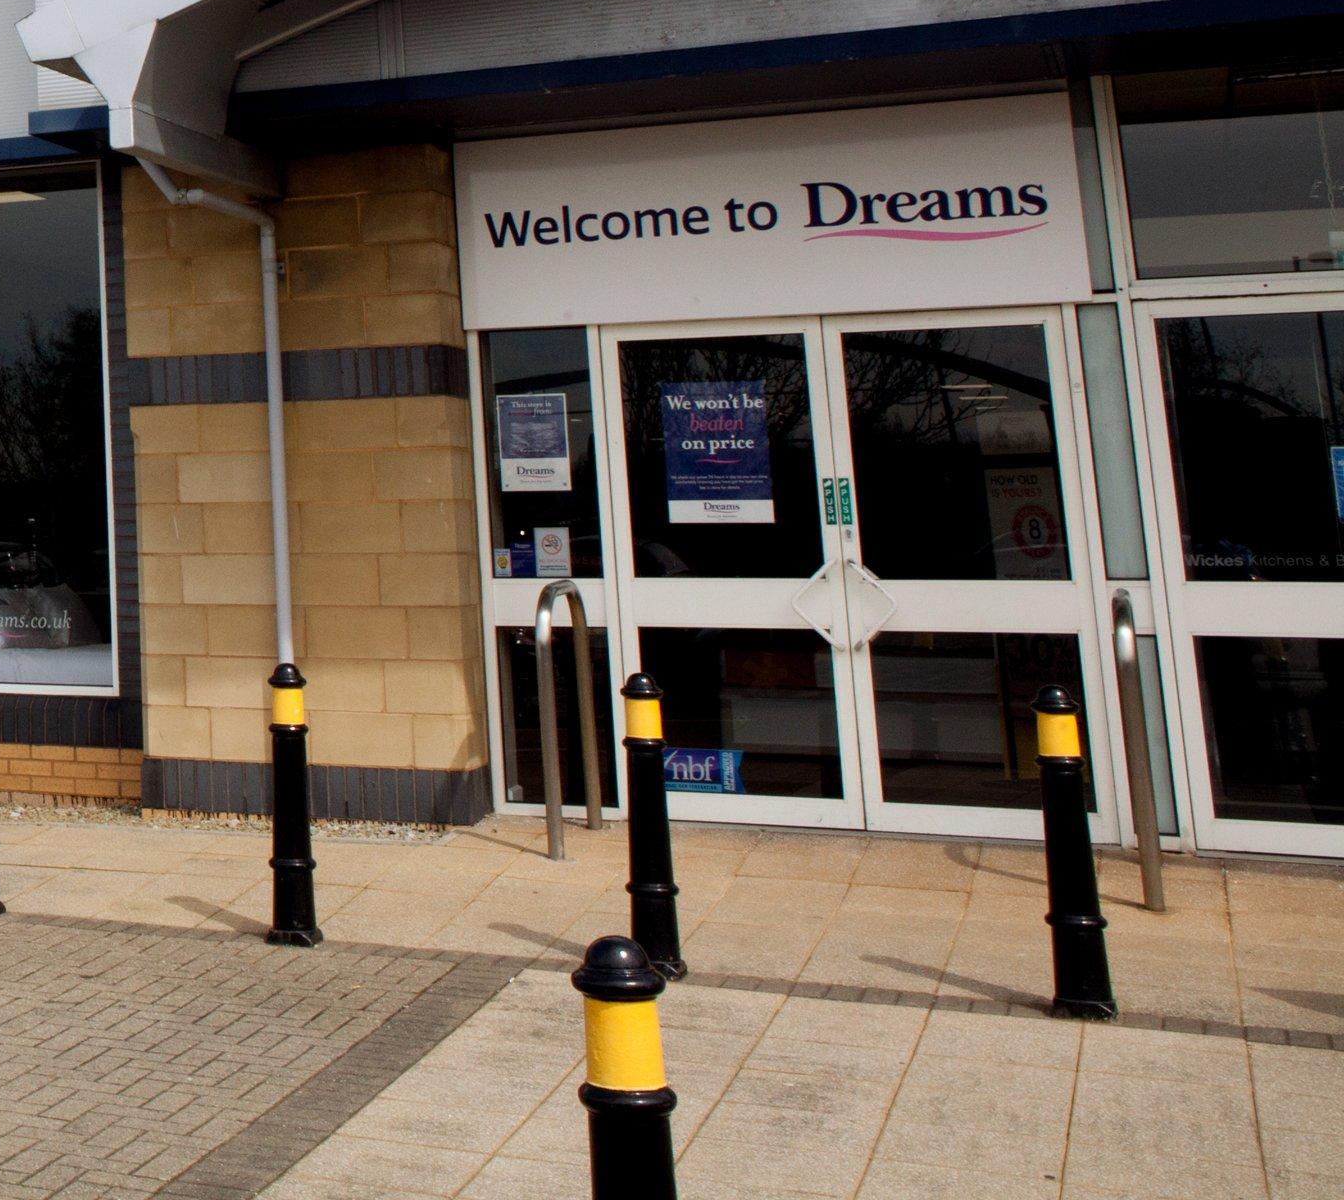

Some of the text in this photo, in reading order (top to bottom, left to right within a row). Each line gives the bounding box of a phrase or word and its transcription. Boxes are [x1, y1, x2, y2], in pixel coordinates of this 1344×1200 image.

[484, 181, 1049, 248] Welcome to Dreams
[665, 393, 764, 410] We won't be
[690, 412, 744, 432] beaten
[681, 434, 755, 455] on price
[516, 465, 556, 476] Dreams
[990, 474, 1038, 486] HOW OLD
[1002, 487, 1042, 499] YOURS?
[704, 502, 740, 511] Dreams
[825, 488, 835, 522] PUSH
[840, 488, 851, 522] PUSH
[1028, 518, 1042, 540] 8
[1185, 554, 1244, 567] Wickes
[1248, 554, 1314, 567] Kitchens
[1319, 554, 1330, 567] &
[672, 754, 716, 782] nbf
